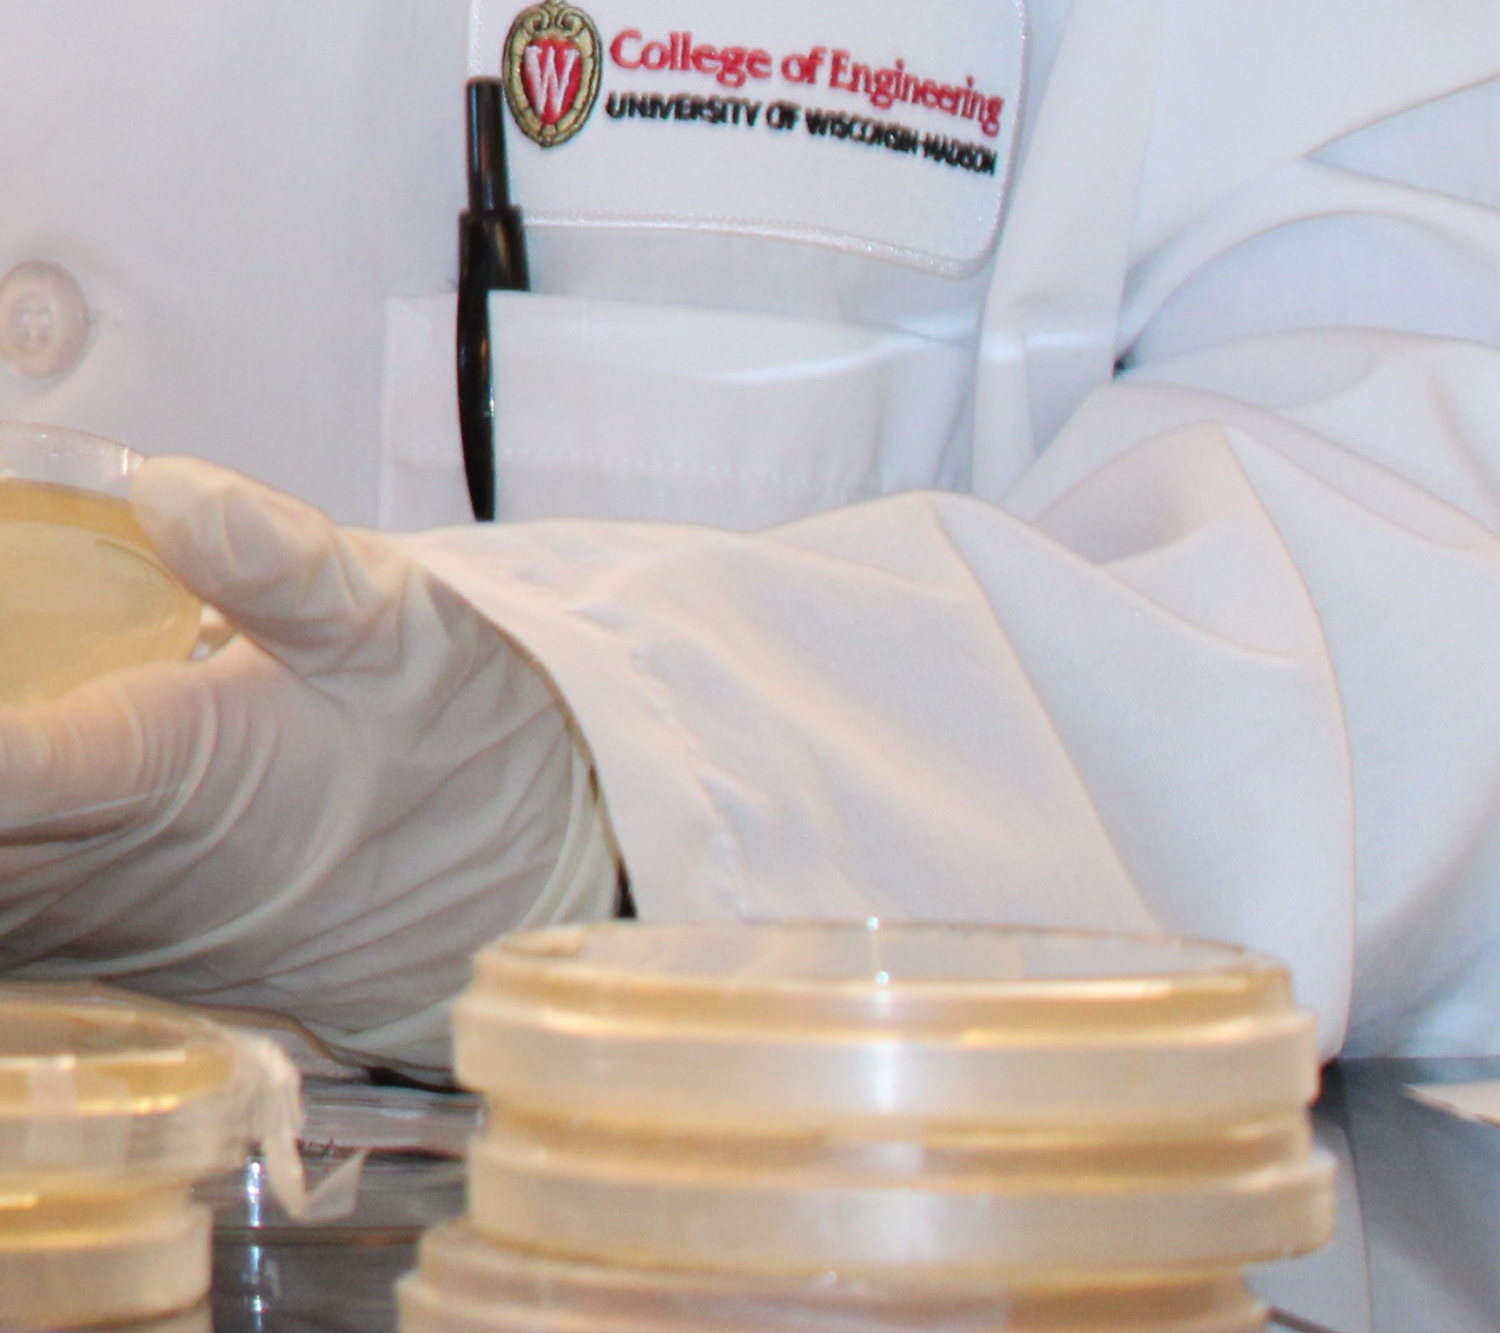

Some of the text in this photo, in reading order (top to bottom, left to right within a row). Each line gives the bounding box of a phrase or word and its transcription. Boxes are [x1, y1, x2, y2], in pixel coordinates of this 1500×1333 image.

[524, 44, 580, 122] W
[605, 90, 762, 127] UNIVERSITY
[765, 99, 801, 130] OF
[609, 28, 1005, 137] College of Engineering
